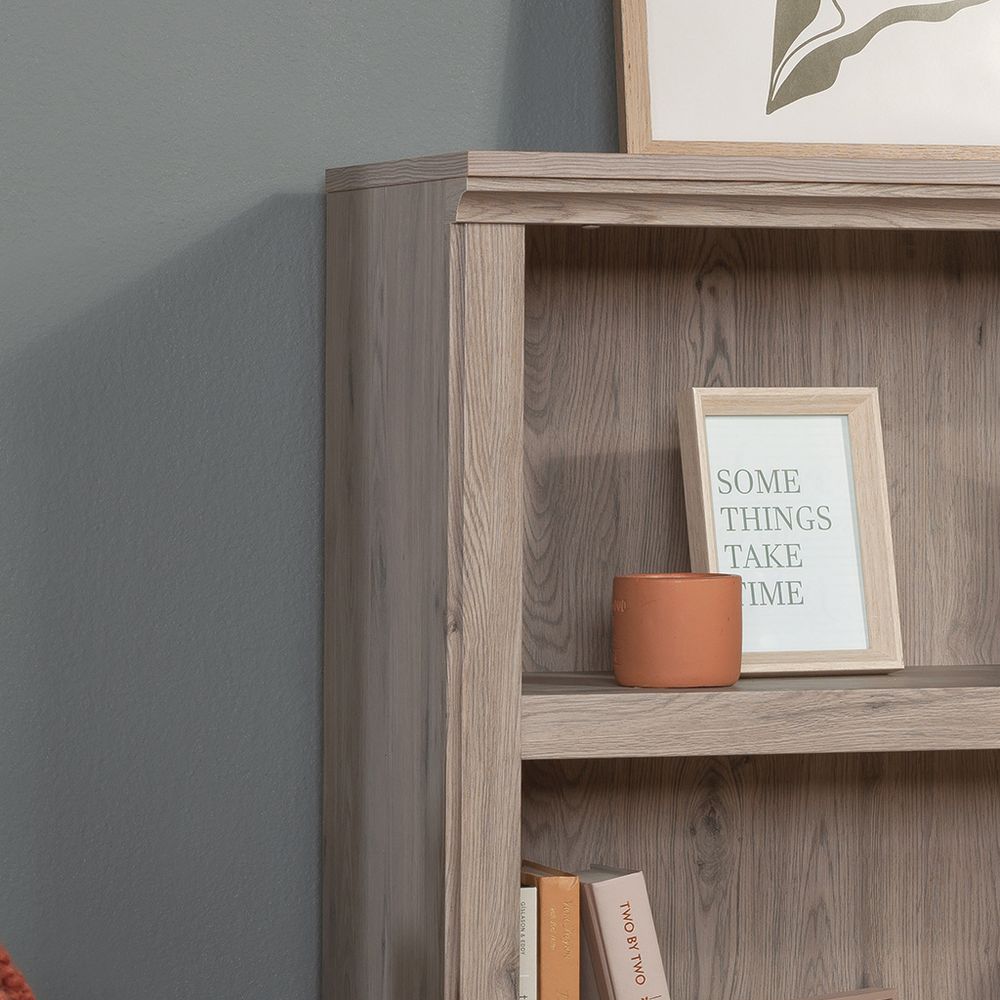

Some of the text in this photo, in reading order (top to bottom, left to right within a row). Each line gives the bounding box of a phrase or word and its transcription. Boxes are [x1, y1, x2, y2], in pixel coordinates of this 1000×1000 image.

[717, 469, 801, 494] SOME
[720, 506, 832, 532] THINGS
[724, 544, 803, 569] TAKE
[742, 581, 804, 606] IME
[620, 901, 646, 985] TWO BY TWO
